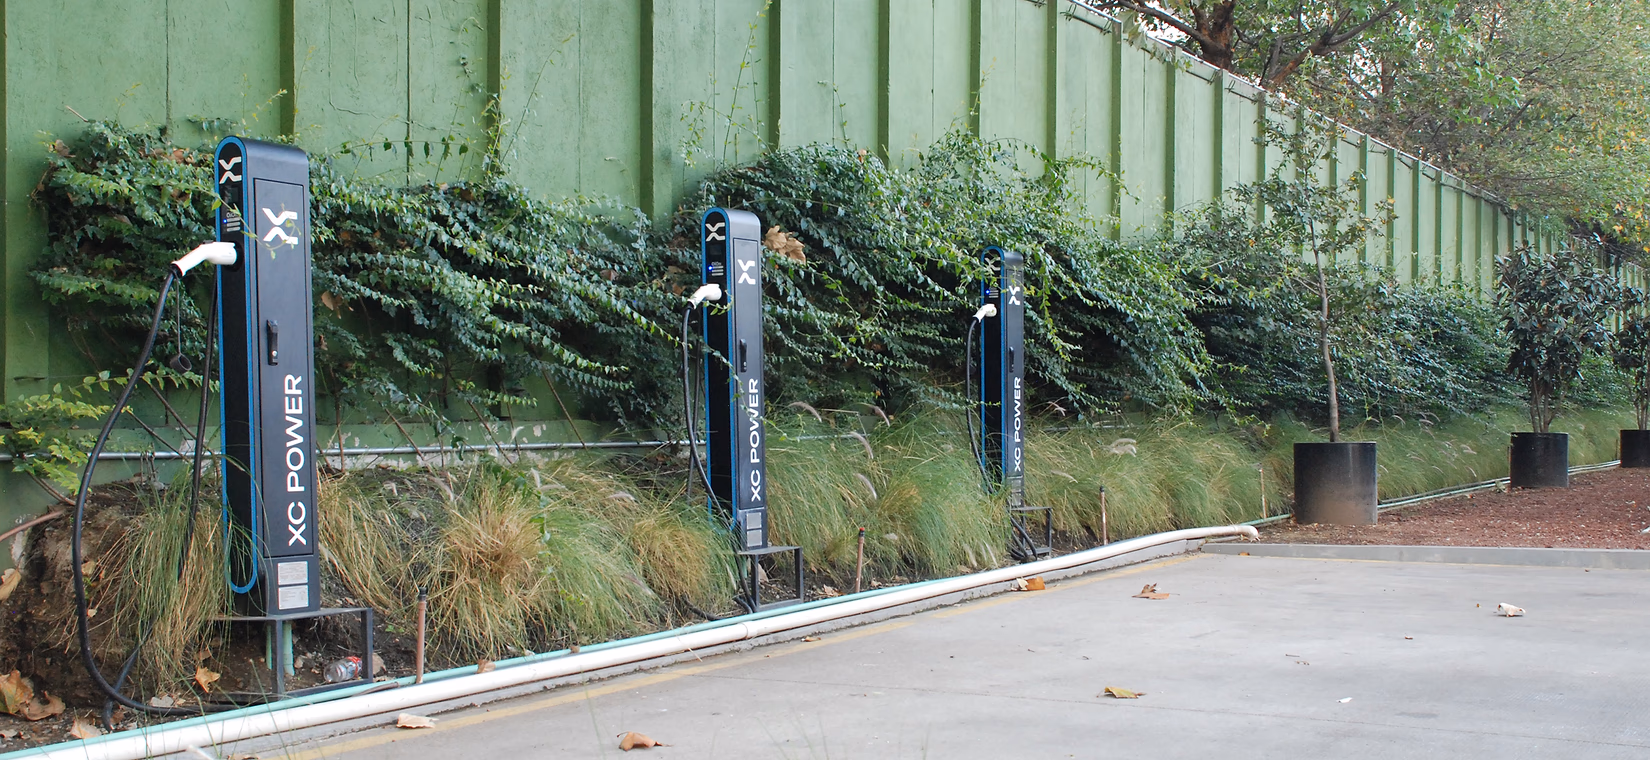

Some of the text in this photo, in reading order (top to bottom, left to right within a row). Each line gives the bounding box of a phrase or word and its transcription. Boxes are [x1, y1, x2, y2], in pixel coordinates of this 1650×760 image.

[284, 373, 305, 492] POWER
[749, 378, 761, 502] XC POWER
[1013, 376, 1021, 472] XC POWER
[287, 501, 307, 547] XC
